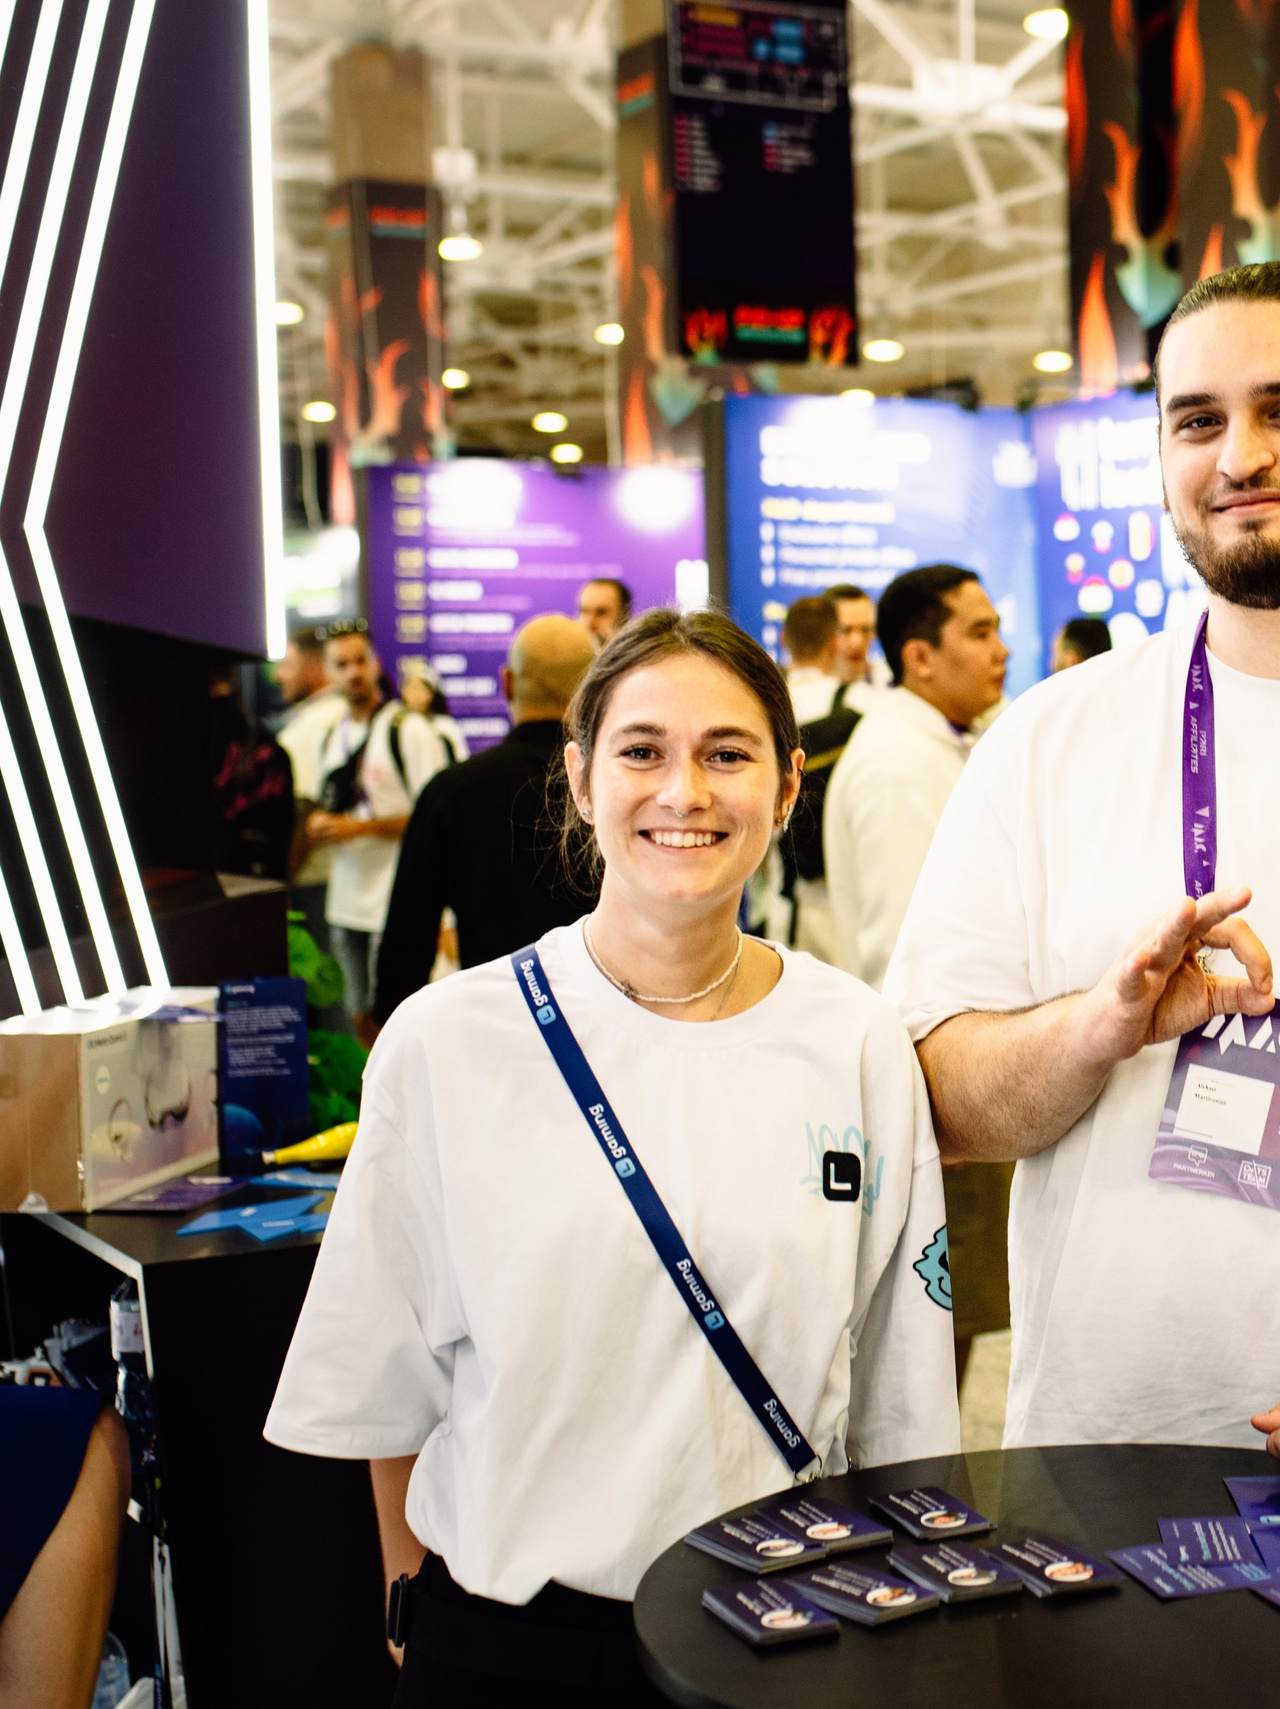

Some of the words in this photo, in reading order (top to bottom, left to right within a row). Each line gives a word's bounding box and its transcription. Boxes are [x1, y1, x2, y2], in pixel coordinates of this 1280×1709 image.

[1189, 715, 1199, 774] AFFILIATES
[520, 959, 549, 1007] gaming
[589, 1103, 627, 1159] gaming
[1173, 1162, 1216, 1179] PARTNERKIN
[676, 1258, 715, 1312] gaming
[763, 1398, 800, 1448] gaming
